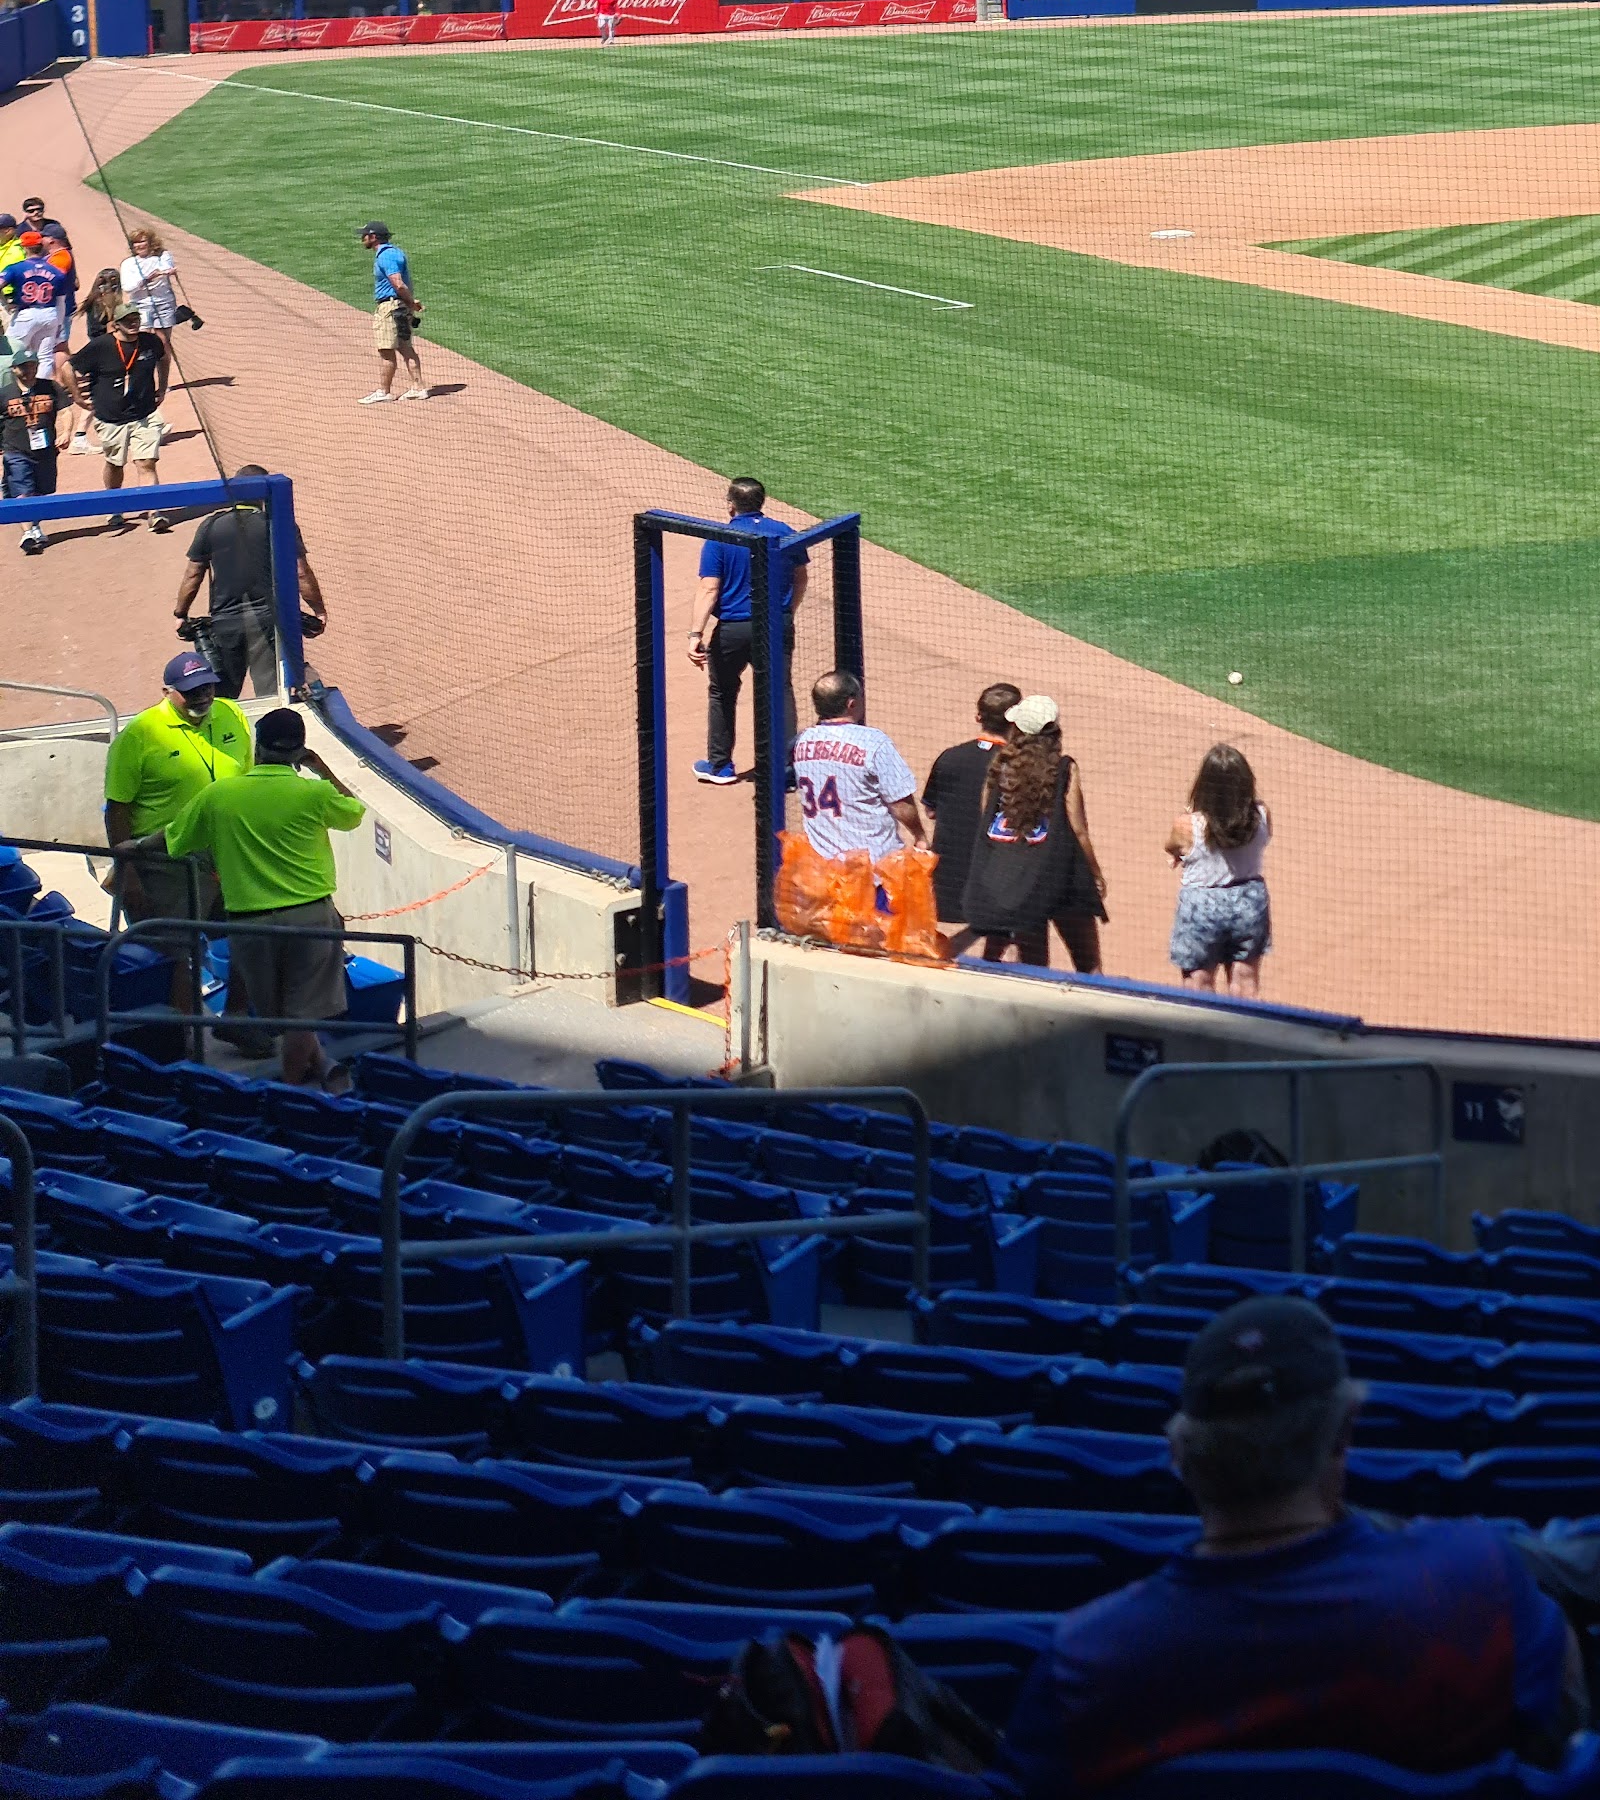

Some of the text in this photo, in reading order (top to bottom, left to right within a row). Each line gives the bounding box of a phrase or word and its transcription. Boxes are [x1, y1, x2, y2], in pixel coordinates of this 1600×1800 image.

[732, 10, 781, 24] Budweiser
[813, 5, 860, 20] Budweiser
[885, 3, 931, 18] Budweiser
[443, 20, 502, 34] Budweiser
[21, 281, 54, 303] 90
[799, 775, 842, 818] 34
